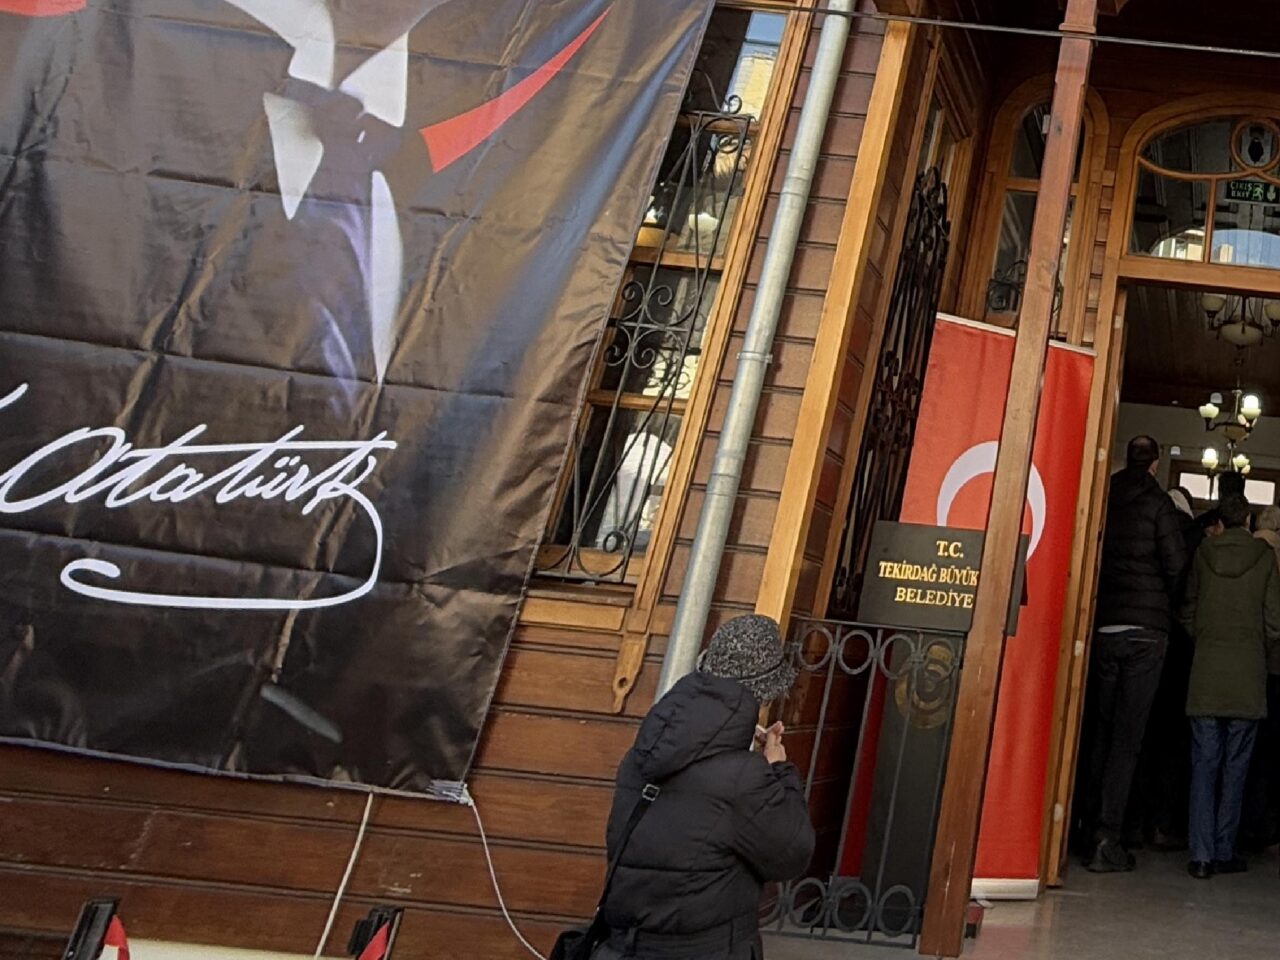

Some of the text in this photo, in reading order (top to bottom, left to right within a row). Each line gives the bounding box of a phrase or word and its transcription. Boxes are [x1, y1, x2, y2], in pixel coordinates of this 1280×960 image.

[936, 540, 964, 558] T.C.
[879, 560, 980, 586] TEKİRDAĞ BÜYÜK
[894, 587, 974, 609] BELEDİYE
